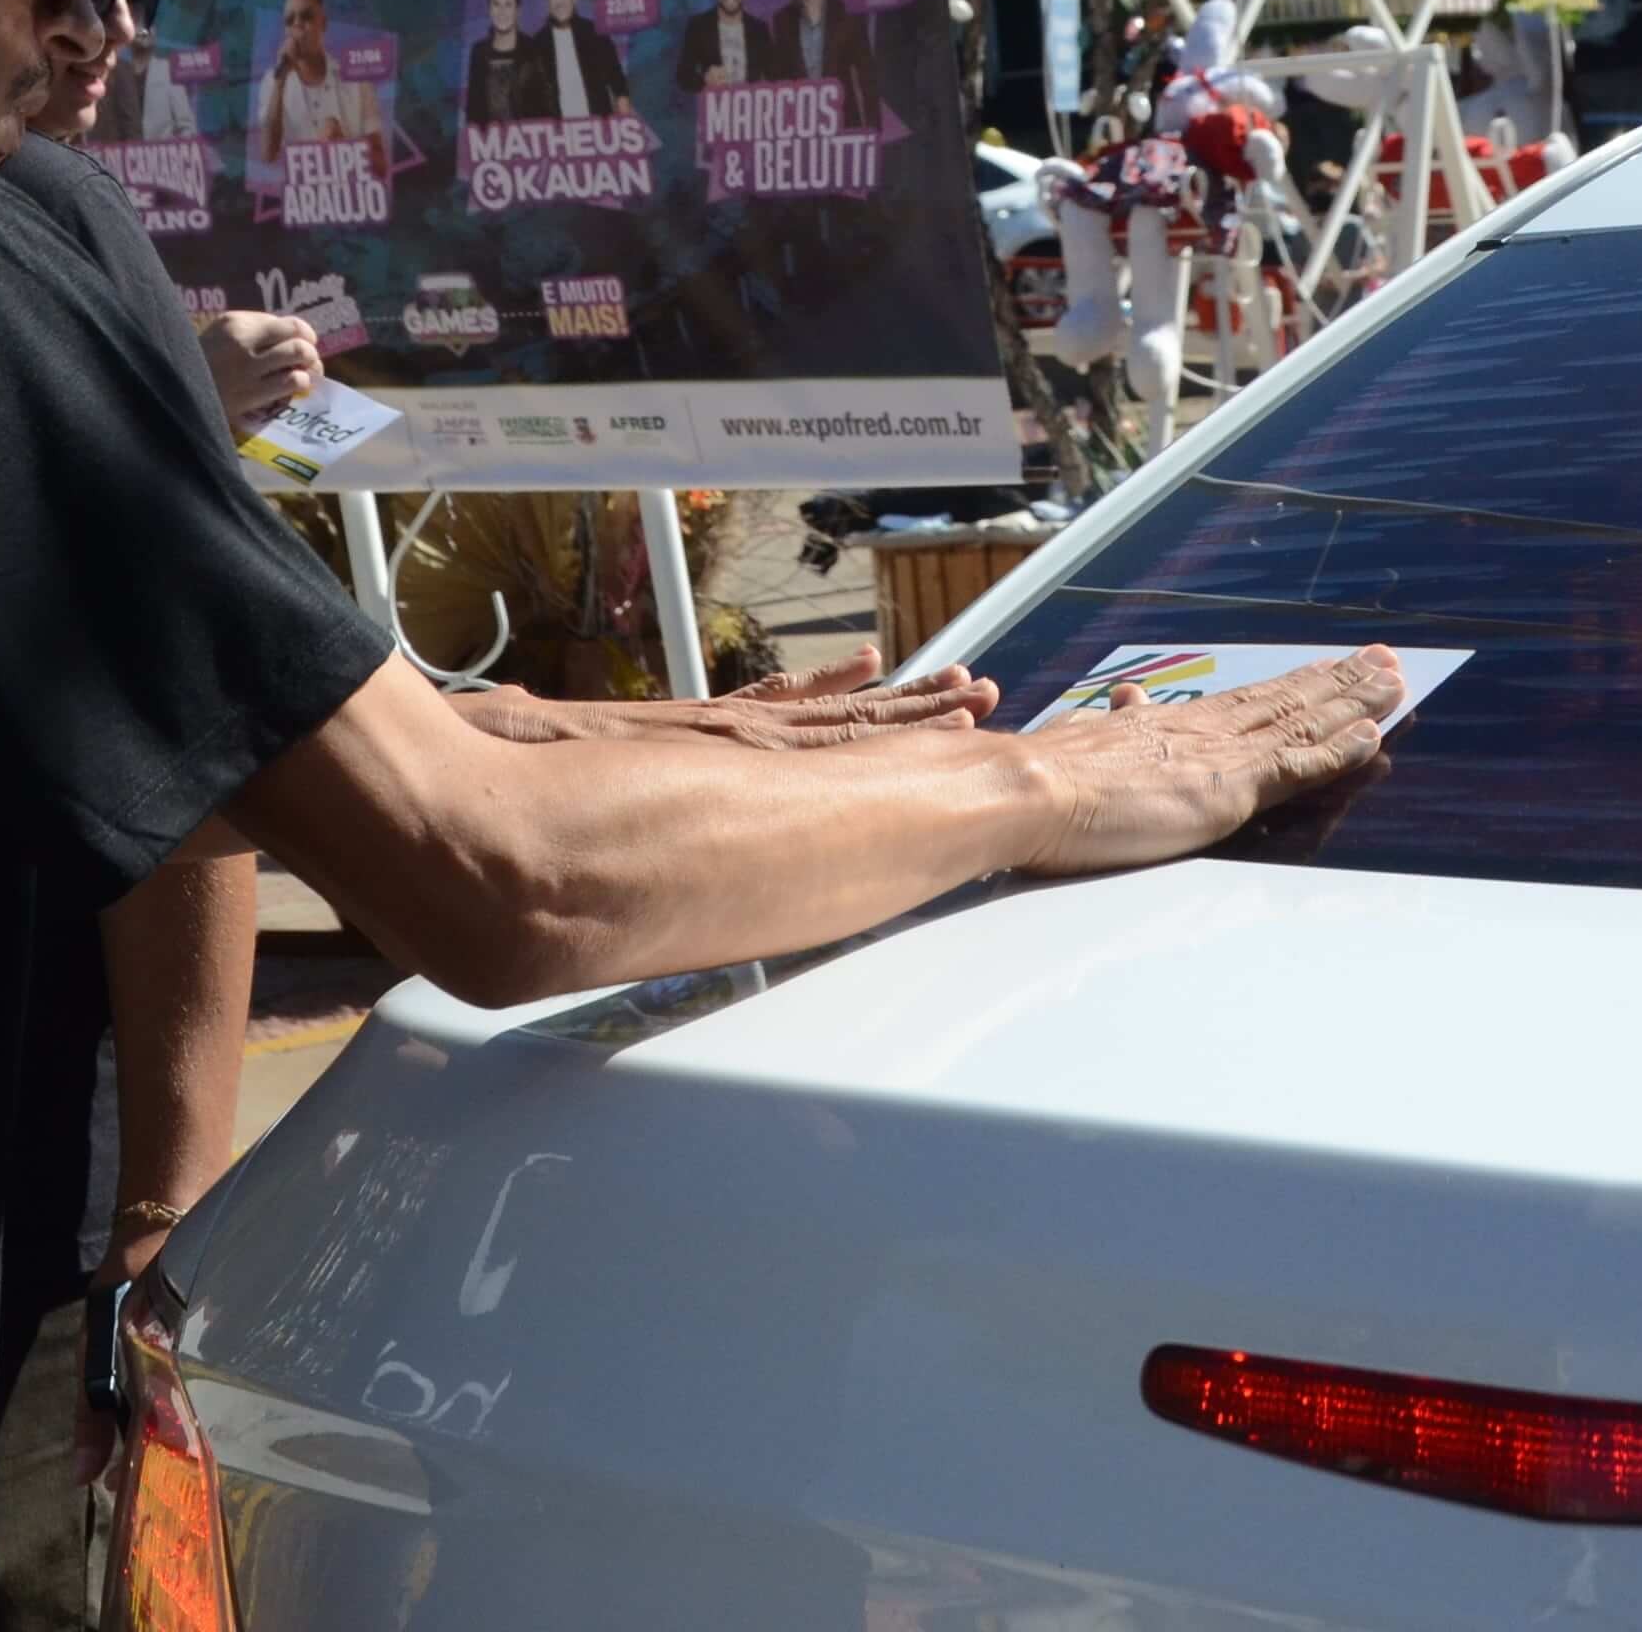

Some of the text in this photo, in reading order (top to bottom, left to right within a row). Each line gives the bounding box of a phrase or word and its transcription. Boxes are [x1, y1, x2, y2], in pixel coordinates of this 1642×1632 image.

[707, 84, 838, 143] MARCOS
[468, 119, 646, 163] MATHEUS
[286, 143, 370, 187] FELIPE
[514, 160, 651, 201] KAUAN
[724, 149, 745, 188] &
[542, 276, 622, 305] E MUITO
[403, 304, 500, 335] GAMES
[548, 304, 630, 337] MAIS!
[609, 416, 666, 431] AFRED
[721, 410, 983, 443] www.expofred.com.br
